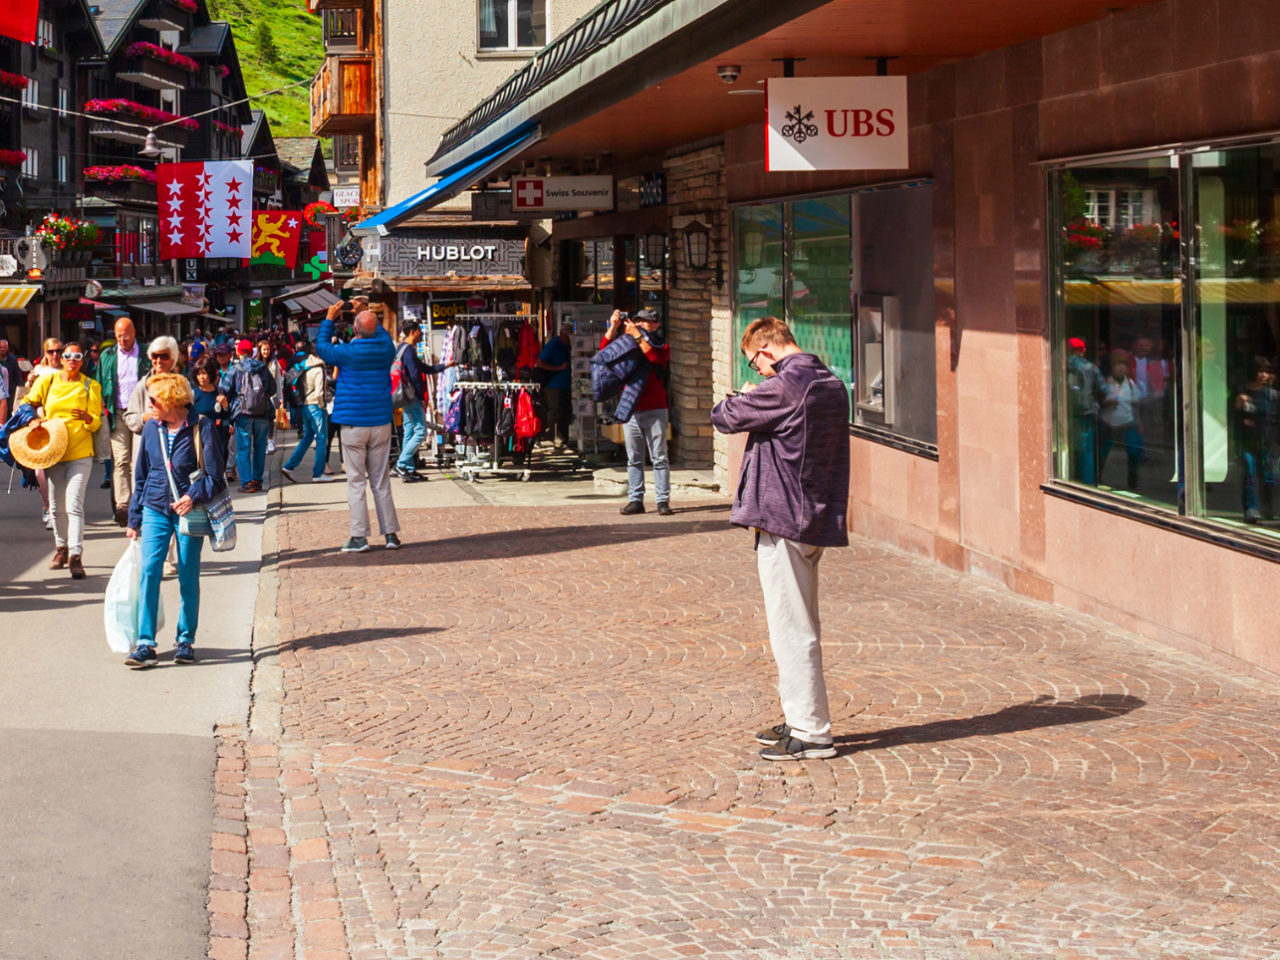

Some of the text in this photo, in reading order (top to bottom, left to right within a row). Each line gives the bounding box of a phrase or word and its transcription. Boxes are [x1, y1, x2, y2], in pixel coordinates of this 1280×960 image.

[824, 108, 896, 137] UBS
[545, 189, 610, 197] Swiss Souvenir
[417, 246, 496, 260] HUBLOT
[433, 303, 465, 318] Books
